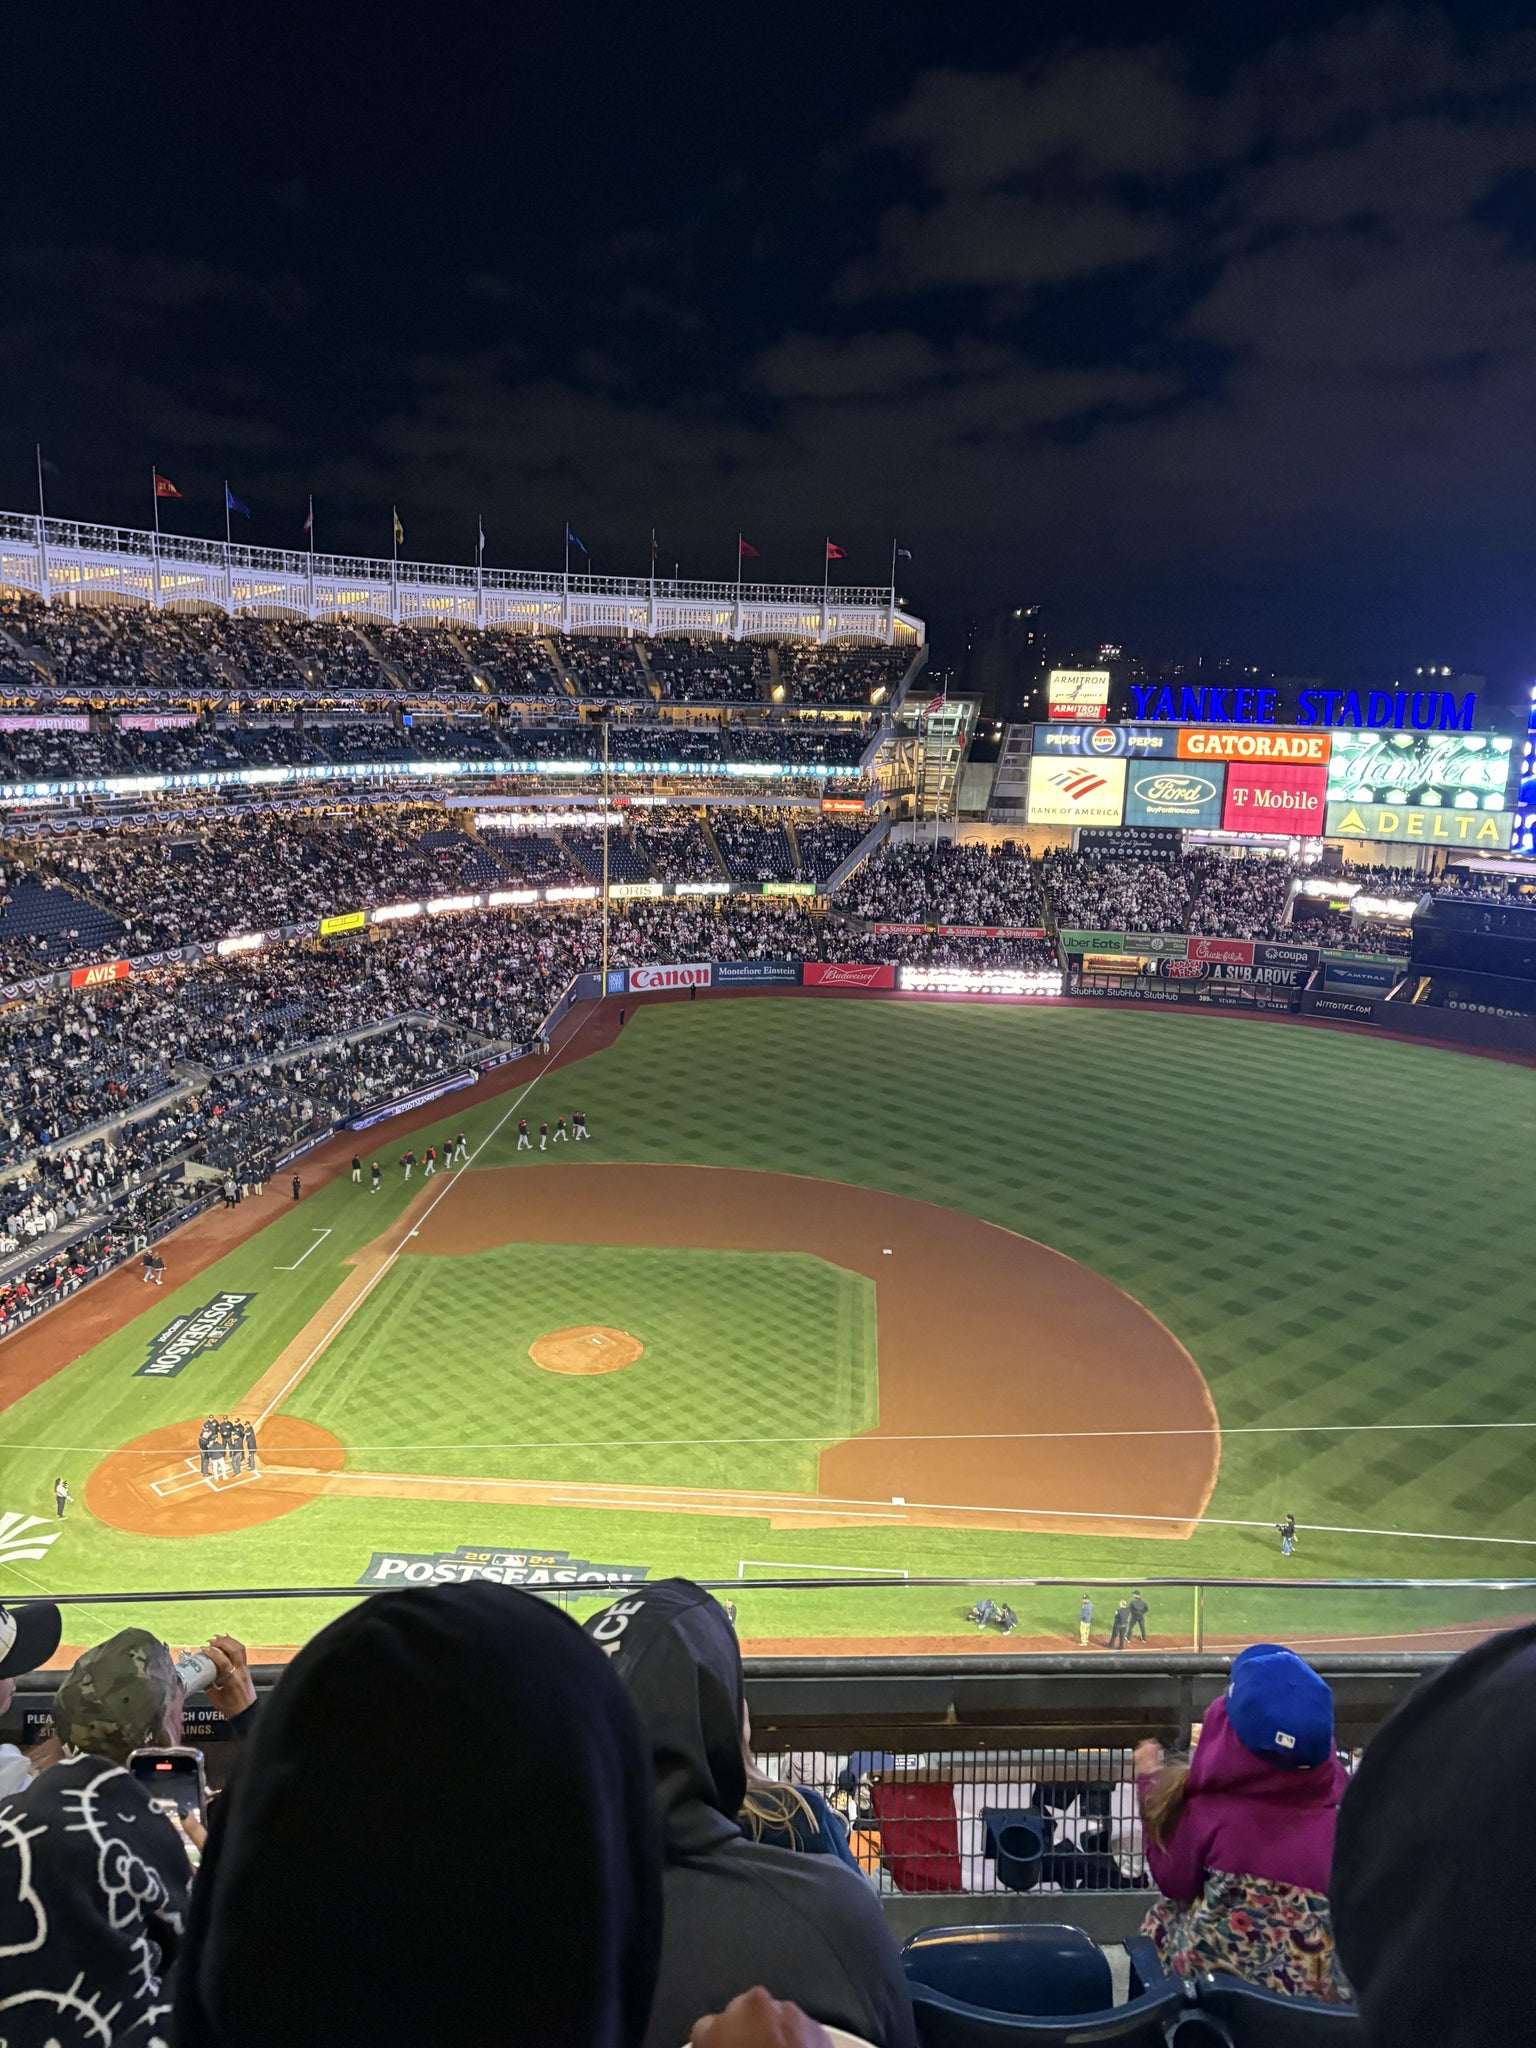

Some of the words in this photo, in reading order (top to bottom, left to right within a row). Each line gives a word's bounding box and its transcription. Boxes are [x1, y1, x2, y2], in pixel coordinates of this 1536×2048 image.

[1053, 676, 1107, 685] ARMITRON
[1053, 704, 1102, 713] ARMITRON
[1130, 684, 1277, 724] YANKEE
[1297, 689, 1479, 732] STADIUM
[36, 718, 63, 730] PARTY
[65, 717, 88, 730] DECK
[1046, 733, 1081, 745] PEPSI
[1094, 736, 1115, 744] PEPSI
[1128, 736, 1163, 748] PEPSI
[1187, 734, 1323, 758] GATORADE
[1341, 740, 1491, 802] Yankees
[1148, 779, 1202, 801] Ford
[1254, 789, 1319, 810] Mobile
[1031, 807, 1058, 815] BANK
[1060, 807, 1072, 815] OF
[1074, 808, 1120, 817] AMERICA
[1378, 812, 1500, 841] DELTA
[619, 885, 652, 897] ORIS
[1063, 937, 1092, 948] Uber
[1093, 938, 1121, 950] Eats
[1279, 951, 1308, 961] coupa
[718, 965, 761, 976] Montefiore
[763, 965, 796, 975] Einstein
[1166, 959, 1204, 970] Jersey
[85, 964, 117, 985] AVIS
[630, 967, 709, 990] Canon
[824, 969, 874, 981] Budweiser
[1213, 969, 1222, 978] A
[1226, 969, 1252, 982] SUB
[1255, 970, 1298, 985] ABOVE
[1346, 971, 1386, 982] AMTRAK
[1070, 986, 1105, 996] StubHub
[1107, 987, 1142, 998] StubHub
[1143, 990, 1179, 1001] StubHub
[1268, 1001, 1289, 1009] CLEAR
[1315, 999, 1372, 1015] NITTOTIRE.COM
[401, 1092, 436, 1112] POSTSEASON
[143, 1294, 248, 1374] POSTSEASON
[464, 1552, 490, 1562] 20
[529, 1555, 556, 1566] 24
[373, 1559, 633, 1586] POSTSEASON
[27, 1713, 54, 1724] PLEA
[182, 1711, 196, 1722] CH
